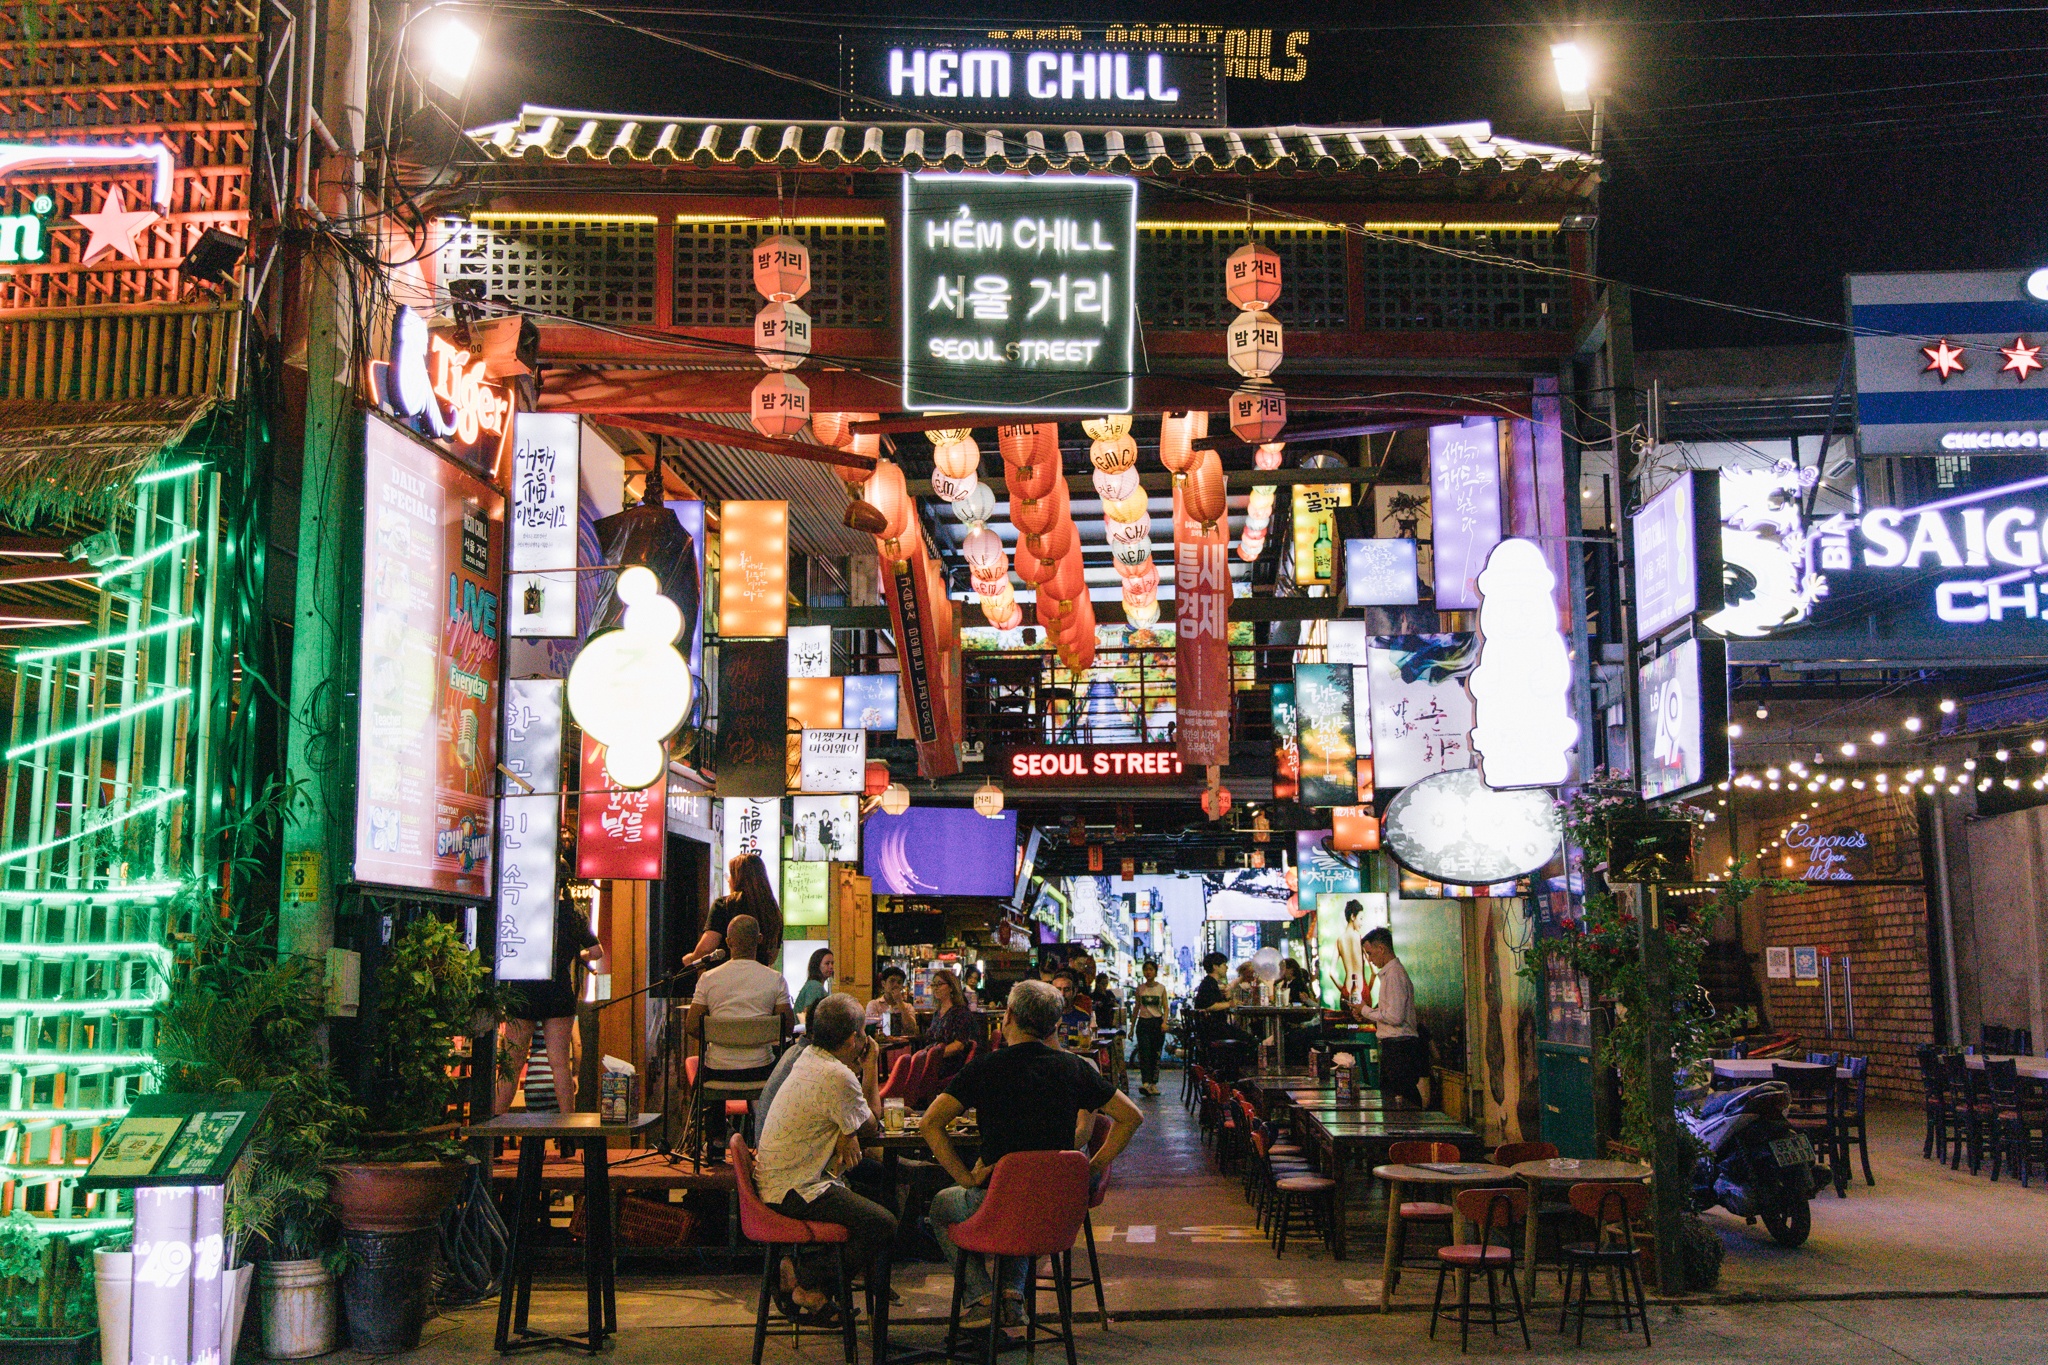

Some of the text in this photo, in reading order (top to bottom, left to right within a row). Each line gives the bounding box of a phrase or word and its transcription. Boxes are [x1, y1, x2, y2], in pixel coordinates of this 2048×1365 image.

[1027, 51, 1179, 102] CHILL
[1013, 217, 1115, 252] CHILL
[758, 251, 803, 271] 밤 거리
[1233, 259, 1277, 278] 밤 거리
[928, 272, 1110, 326] 서울 거리
[762, 319, 808, 339] 밤 거리
[1235, 327, 1279, 347] 밤 거리
[929, 337, 1100, 364] SEOUL STREET
[432, 334, 508, 444] Tiger
[761, 392, 807, 411] 밤 거리
[1239, 397, 1283, 417] 밤 거리
[1942, 431, 2038, 449] CHICAGO
[392, 466, 426, 499] DAILY
[522, 468, 547, 504] 福
[382, 483, 437, 526] SPECIALS
[464, 537, 487, 561] 서울 거리
[1821, 513, 1853, 570] BIA
[1861, 507, 2048, 568] SAIG
[1177, 541, 1225, 591] 틈새
[449, 572, 498, 640] LIVE
[1178, 592, 1225, 640] 경제
[446, 607, 495, 663] Music
[450, 665, 488, 704] Everyday
[1654, 677, 1683, 766] 49
[808, 743, 859, 754] 마이웨이
[1012, 753, 1088, 776] SEOUL
[437, 803, 459, 816] EVERYDAY
[601, 808, 643, 842] 날들
[438, 828, 464, 858] SPIN
[471, 832, 490, 860] WIN
[1786, 823, 1867, 862] Capone's
[1818, 847, 1847, 869] Open
[1439, 856, 1476, 876] 한국
[135, 1240, 192, 1288] 49
